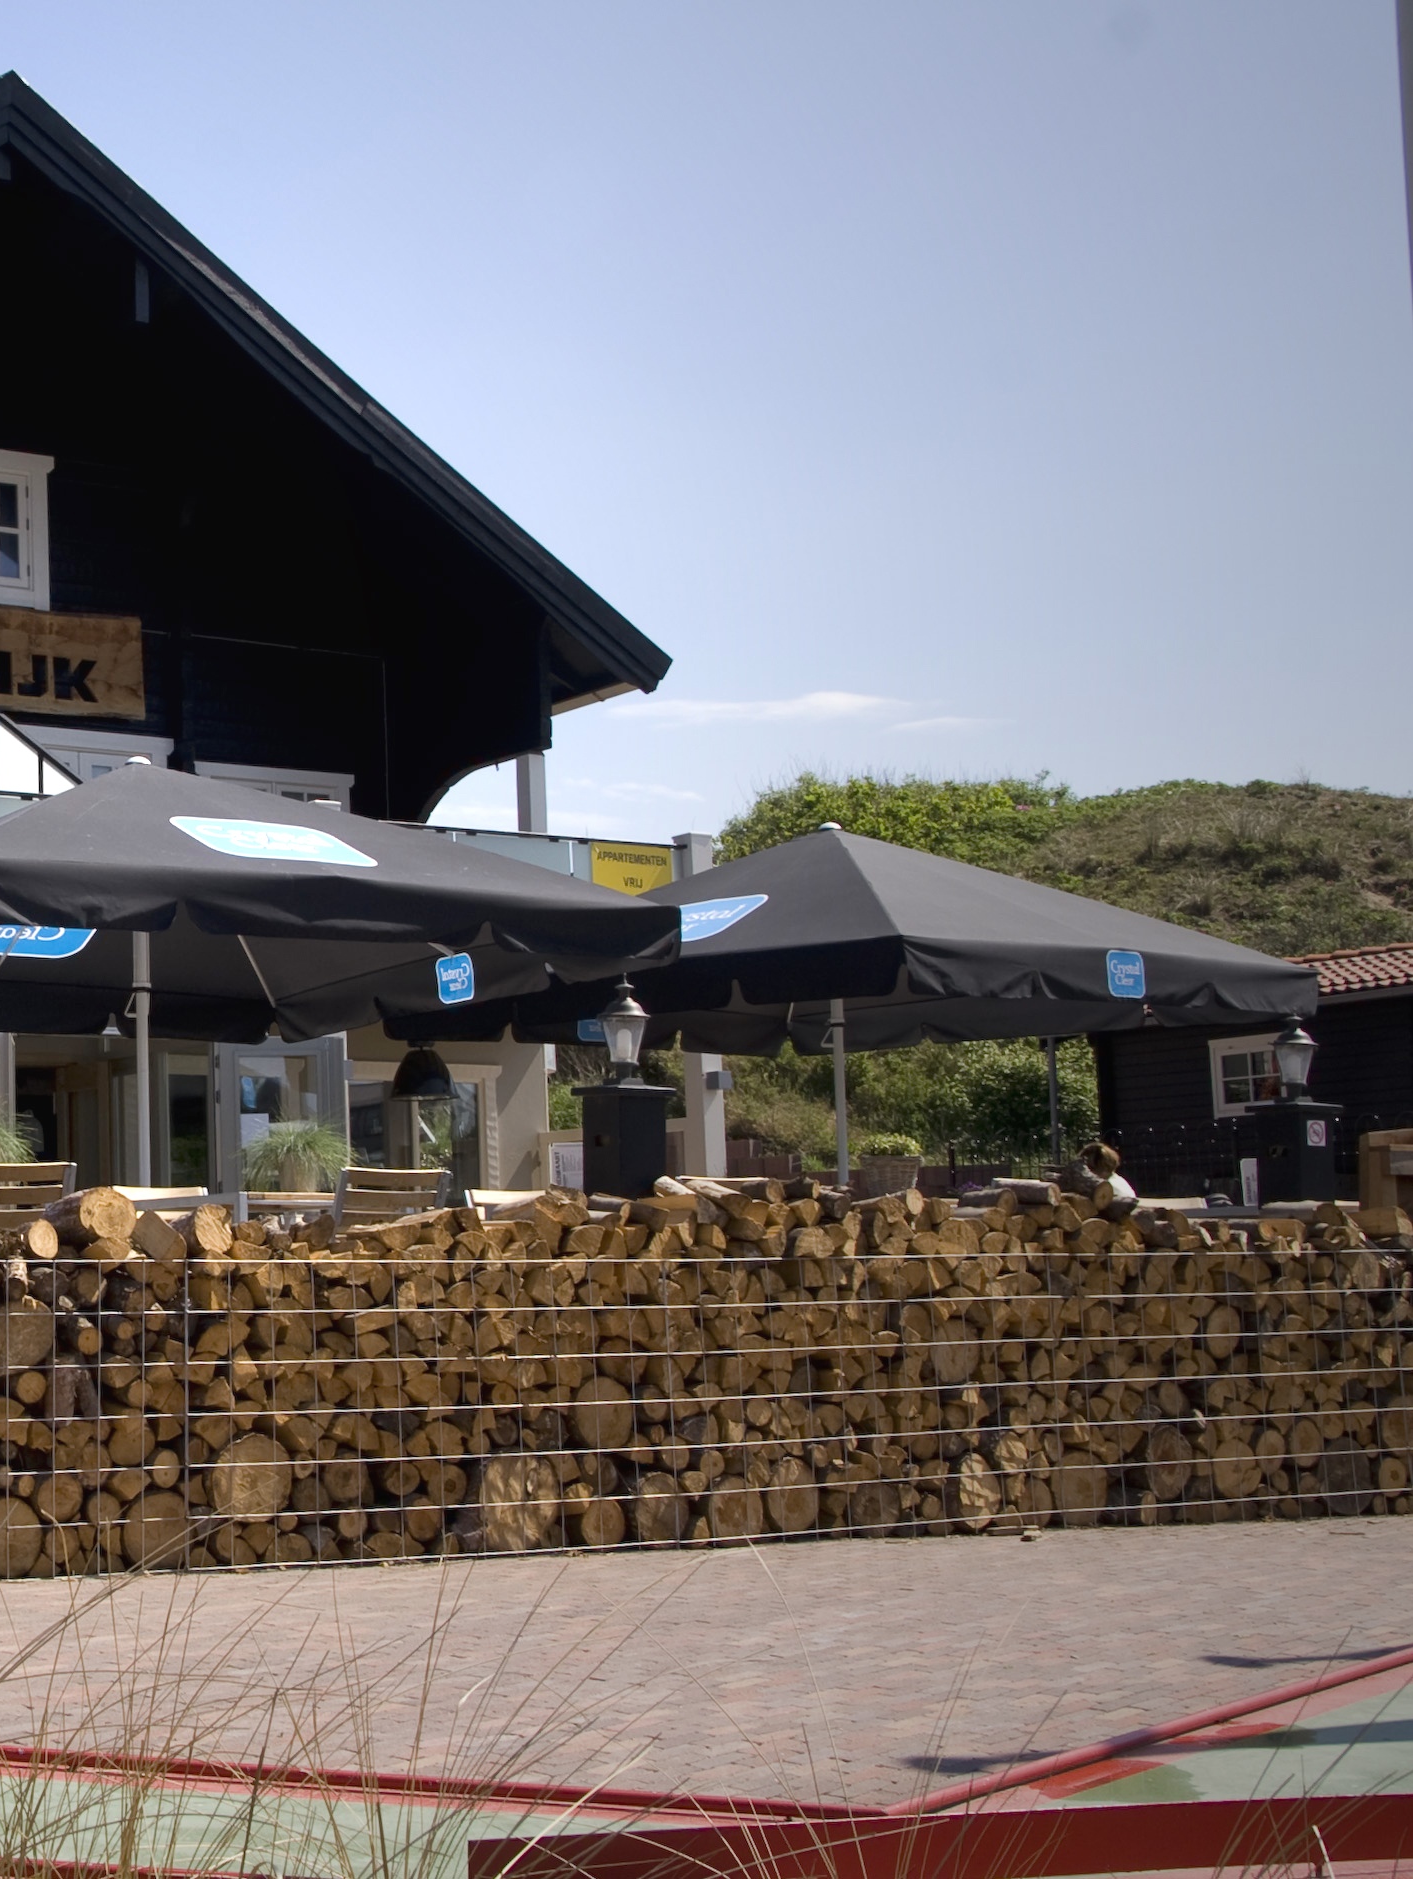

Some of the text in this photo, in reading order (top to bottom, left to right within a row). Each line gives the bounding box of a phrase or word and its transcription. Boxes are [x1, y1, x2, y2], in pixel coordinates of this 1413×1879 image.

[596, 850, 667, 866] APPARTEMENTEN
[622, 875, 643, 889] VRIJ
[1110, 960, 1141, 975] Crystal
